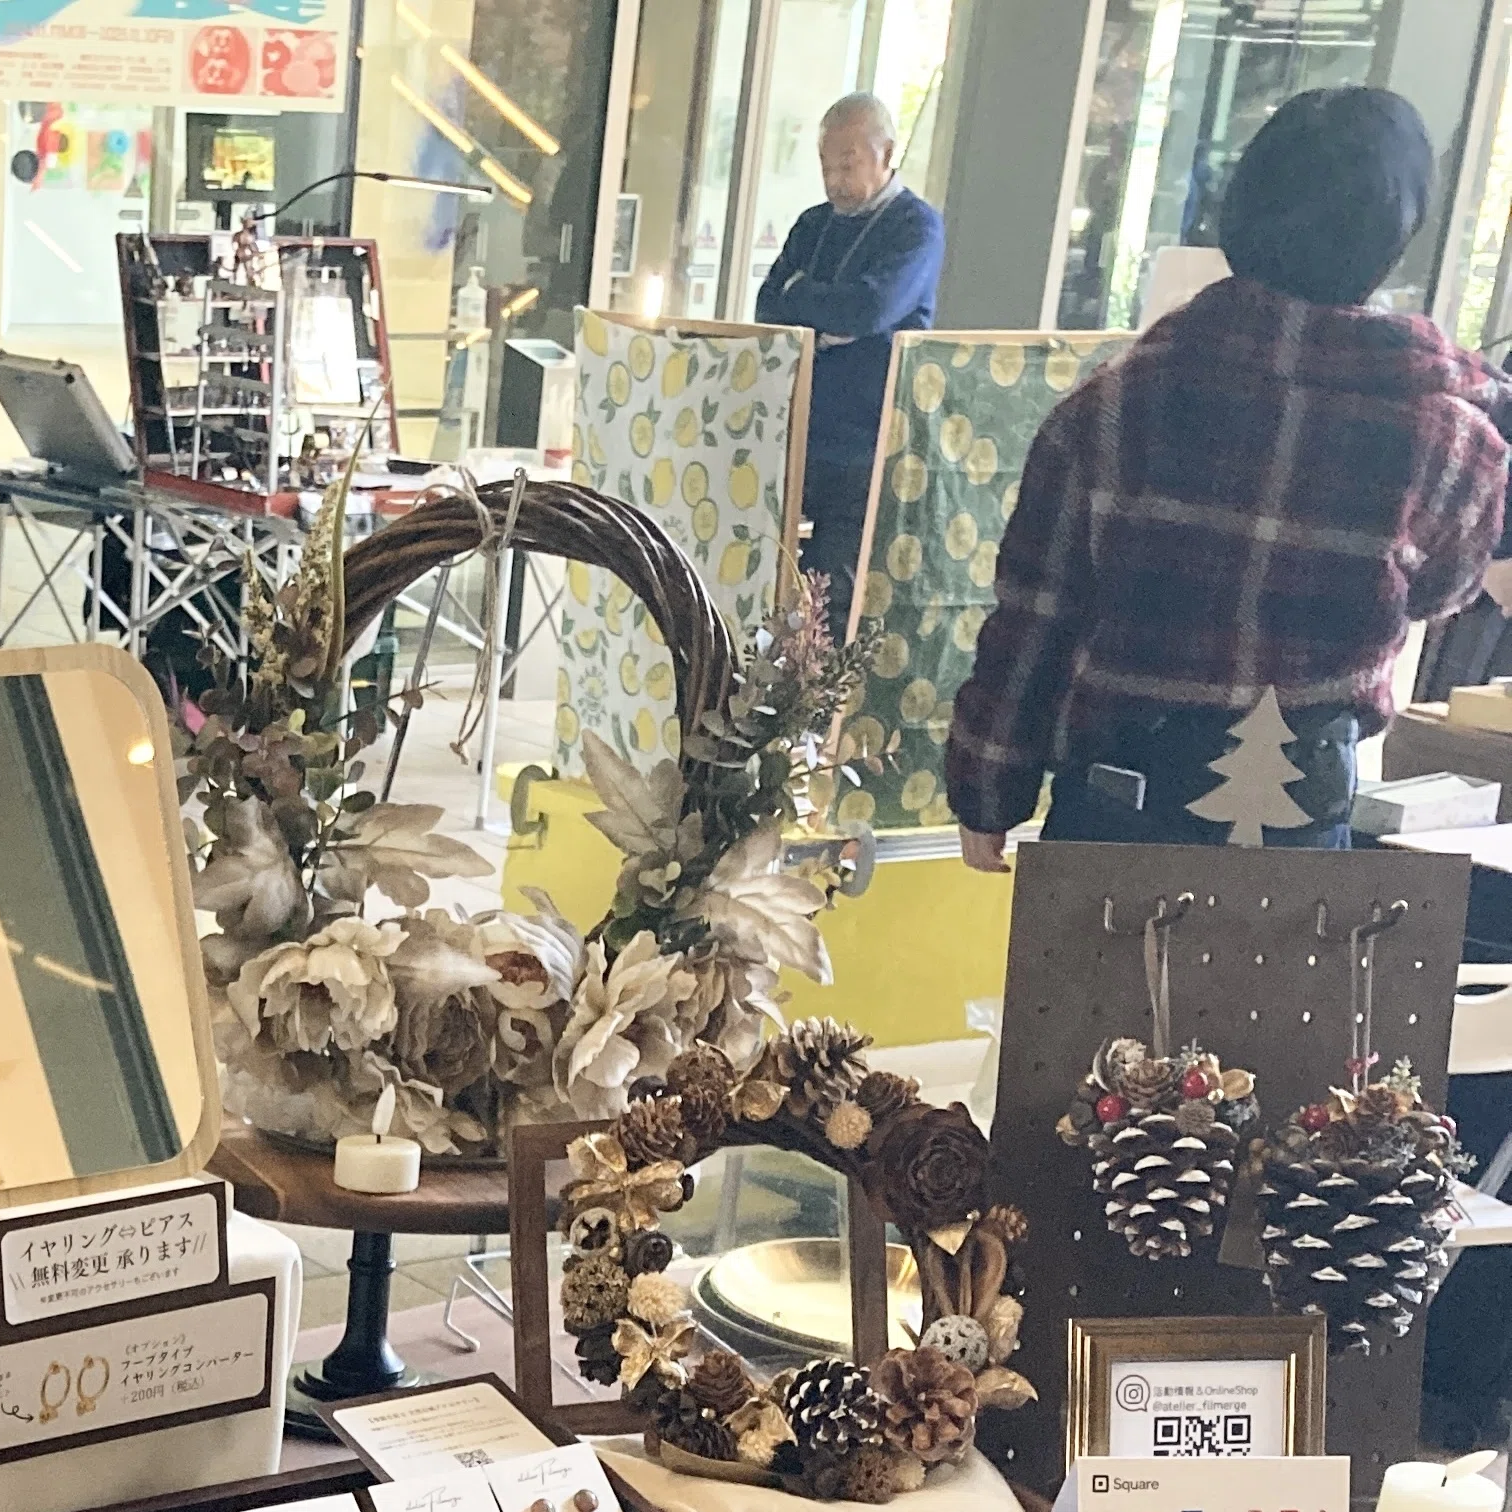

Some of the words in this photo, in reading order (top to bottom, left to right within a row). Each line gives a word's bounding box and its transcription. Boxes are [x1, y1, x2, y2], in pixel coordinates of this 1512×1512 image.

[20, 1224, 118, 1262] イヤリング
[140, 1212, 194, 1237] ピアス
[31, 1252, 109, 1289] 無料変更
[116, 1236, 193, 1270] 承ります
[1113, 1477, 1160, 1492] Square
